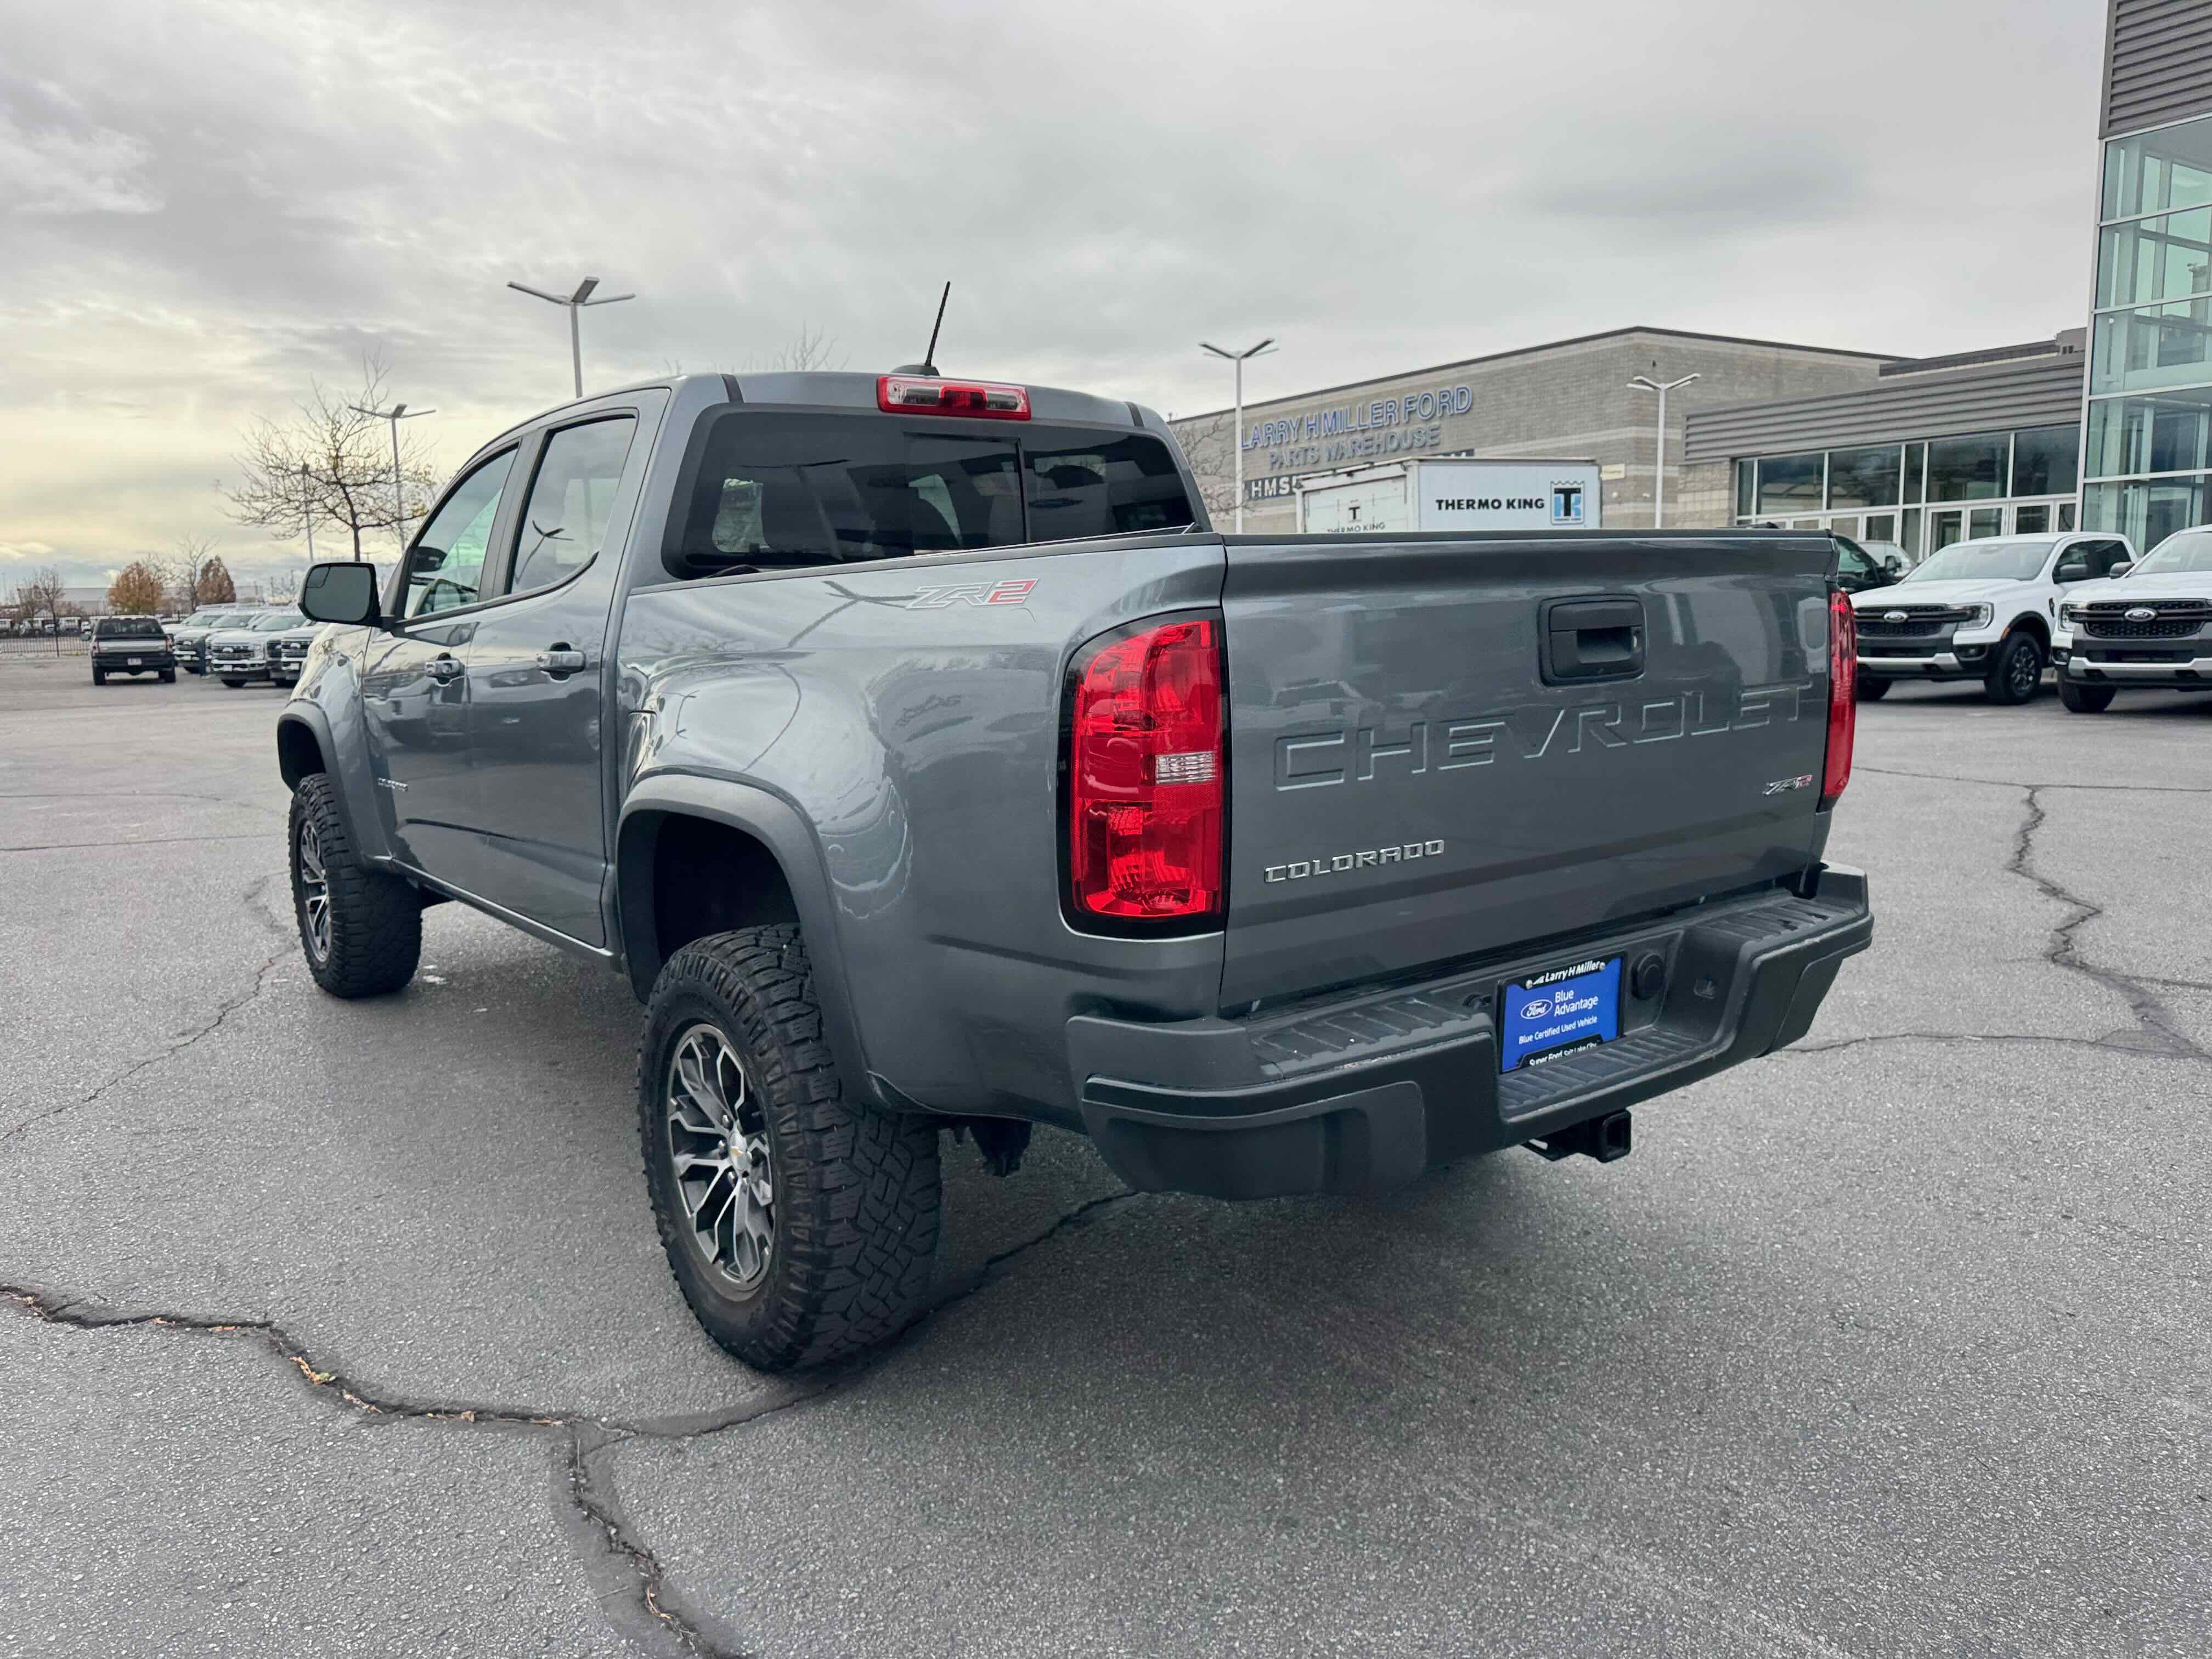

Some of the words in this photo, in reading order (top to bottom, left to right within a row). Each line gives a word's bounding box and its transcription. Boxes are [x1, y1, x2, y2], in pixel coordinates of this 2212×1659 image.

[1241, 416, 1301, 450] LARRY
[1304, 413, 1318, 439] H
[1321, 400, 1400, 436] MILLER
[1403, 386, 1472, 423] FORD
[1268, 443, 1320, 470] PARTS
[1325, 423, 1441, 461] WAREHOUSE
[1436, 499, 1502, 510] THERMO
[1506, 498, 1545, 510] KING
[1363, 522, 1386, 532] KING
[905, 578, 1040, 610] ZR2
[1274, 676, 1812, 791] CHEVROLET
[1264, 839, 1444, 883] COLORADO
[1545, 969, 1568, 983] Larry
[1568, 966, 1576, 976] H
[1576, 960, 1600, 974] Miller
[1525, 1001, 1547, 1018] Ford
[1554, 996, 1599, 1017] Advantage
[1555, 990, 1575, 1003] Blue
[1519, 1033, 1533, 1044] Blue
[1534, 1026, 1560, 1040] Certified
[1561, 1022, 1576, 1032] Used
[1577, 1015, 1598, 1028] Vehicle
